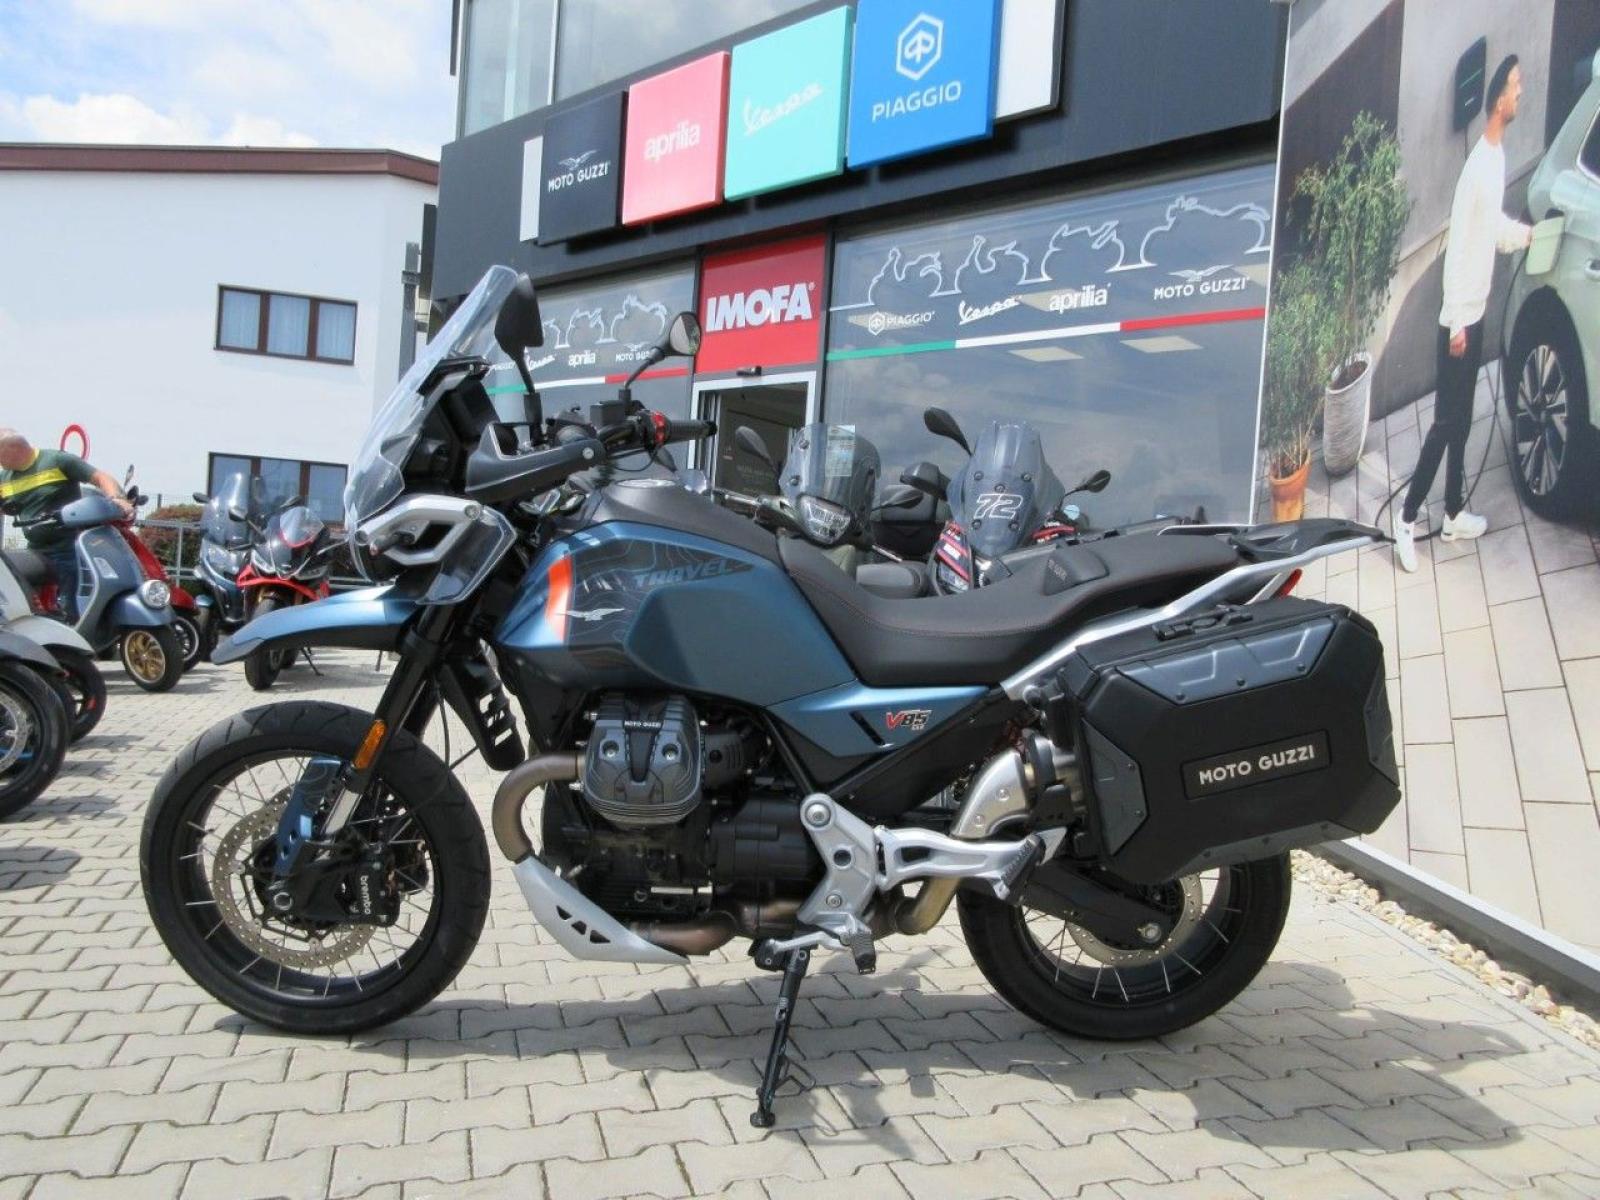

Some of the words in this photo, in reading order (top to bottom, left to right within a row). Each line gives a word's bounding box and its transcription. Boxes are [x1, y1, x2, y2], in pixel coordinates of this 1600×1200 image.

[742, 82, 822, 135] Vespa
[871, 80, 962, 122] PIAGGIO
[644, 121, 701, 163] aprilia
[548, 172, 574, 192] MOTO
[577, 162, 608, 182] GUZZI
[1049, 283, 1108, 314] aprilia
[1154, 284, 1194, 300] MOTO
[1200, 277, 1246, 293] GUZZI
[705, 282, 813, 332] IMOFA
[886, 312, 932, 327] PIAGGIO
[958, 297, 1020, 325] Vespa
[973, 493, 1023, 520] 72
[633, 559, 731, 588] TRAVEL
[886, 709, 932, 730] V85
[1199, 761, 1251, 785] MOTO
[1258, 744, 1315, 770] GUZZI
[360, 874, 371, 915] brembo
